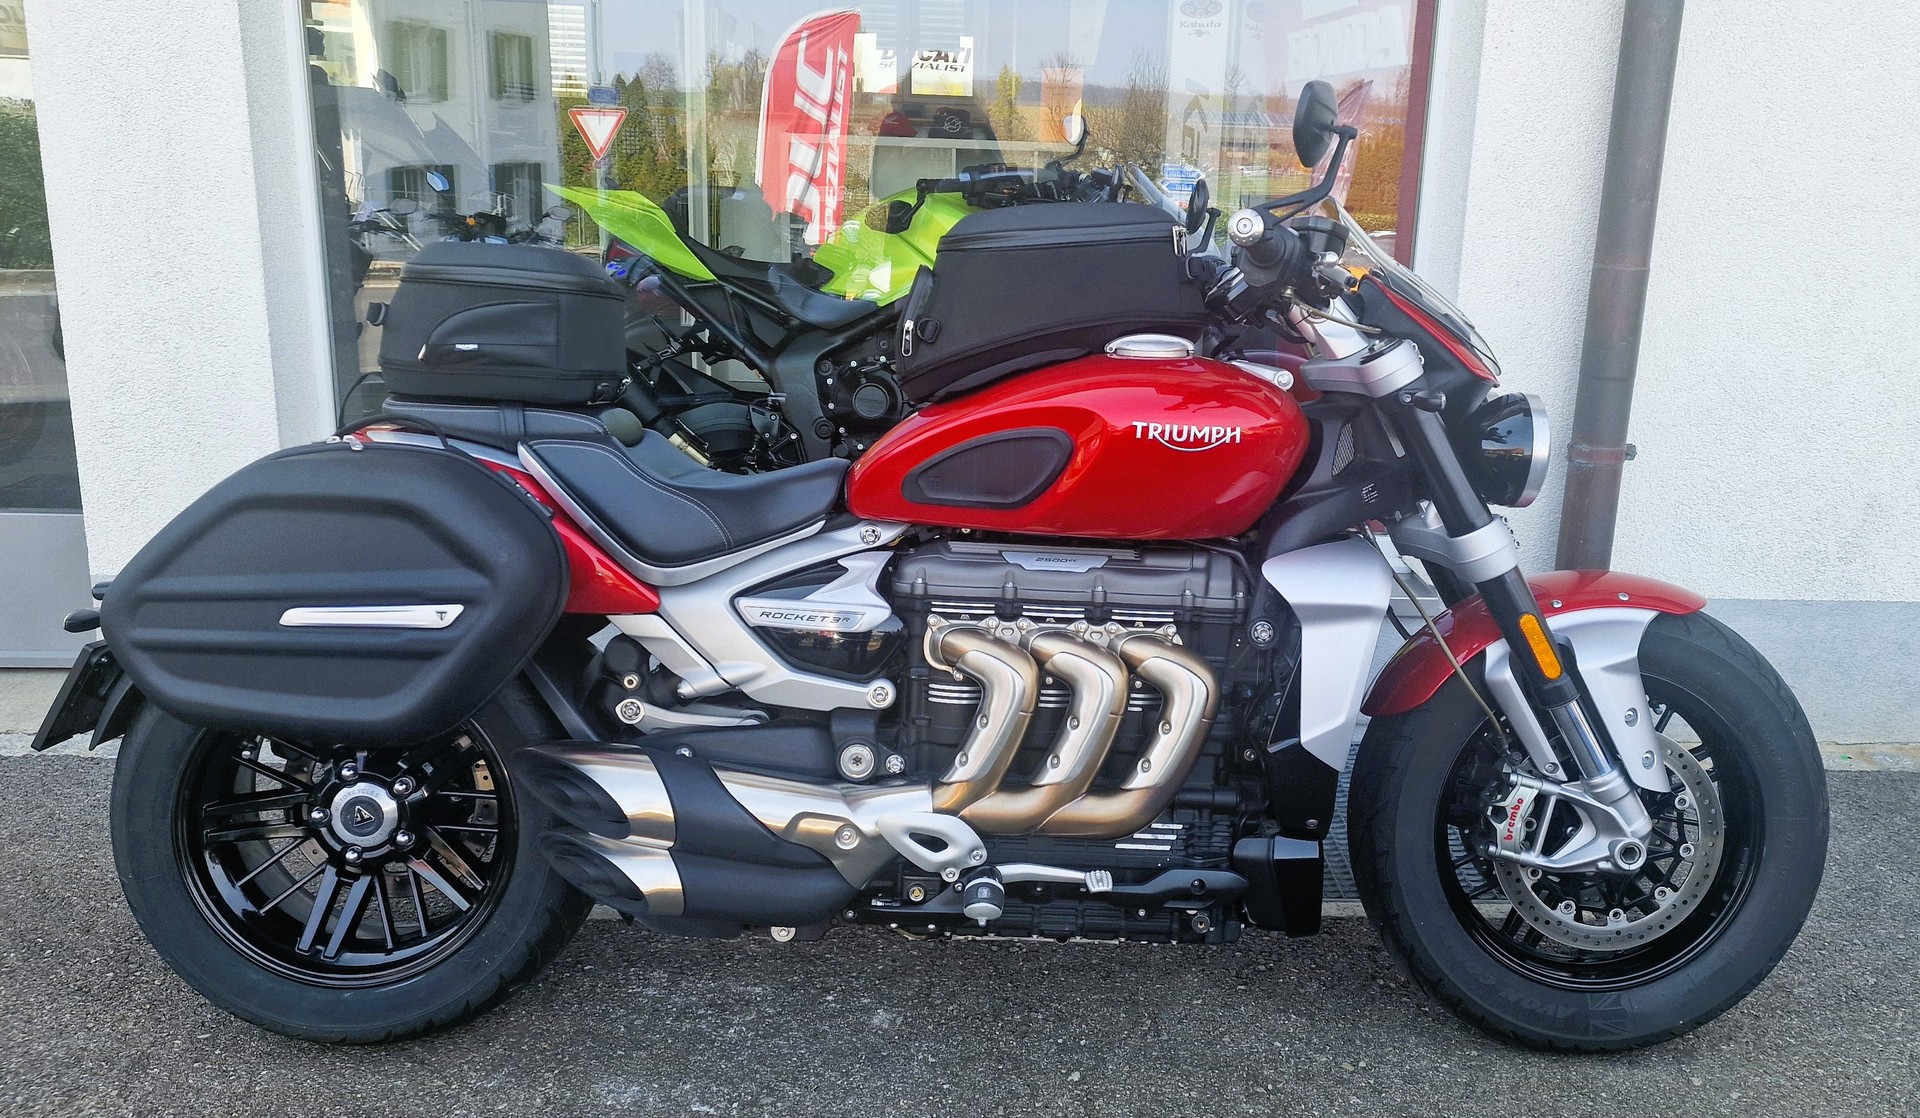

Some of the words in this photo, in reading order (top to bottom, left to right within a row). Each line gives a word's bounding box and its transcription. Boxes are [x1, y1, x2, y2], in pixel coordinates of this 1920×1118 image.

[880, 47, 972, 64] DCATI
[1131, 420, 1242, 453] TRIUMPH
[1503, 797, 1525, 842] brembo
[1497, 988, 1580, 1020] AVON
